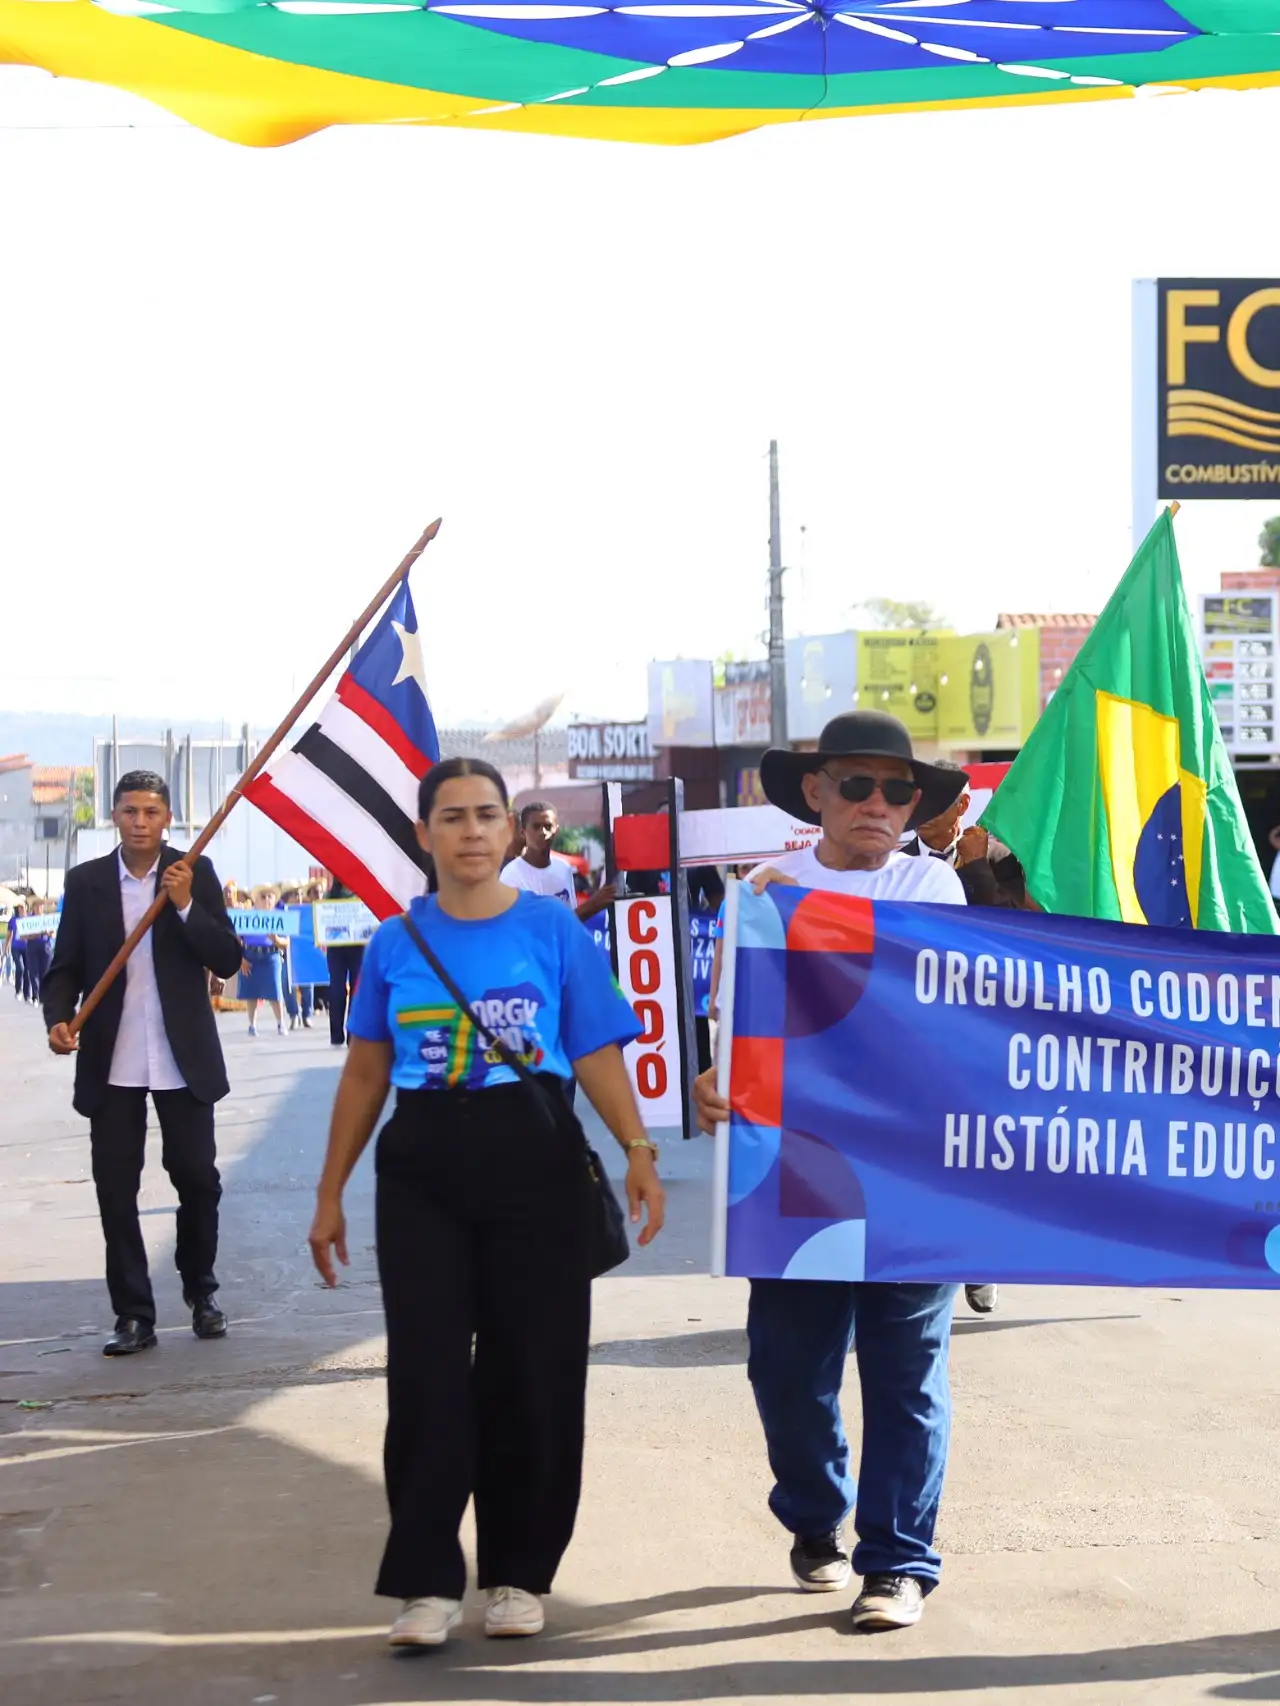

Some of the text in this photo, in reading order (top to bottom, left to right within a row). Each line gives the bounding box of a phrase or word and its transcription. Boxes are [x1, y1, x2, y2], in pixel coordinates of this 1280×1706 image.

[568, 728, 600, 758] BOA
[784, 840, 812, 851] SEJA
[627, 900, 668, 1099] CODÓ
[916, 948, 1112, 1016] ORGULHO
[943, 1105, 1149, 1177] HISTÓRIA
